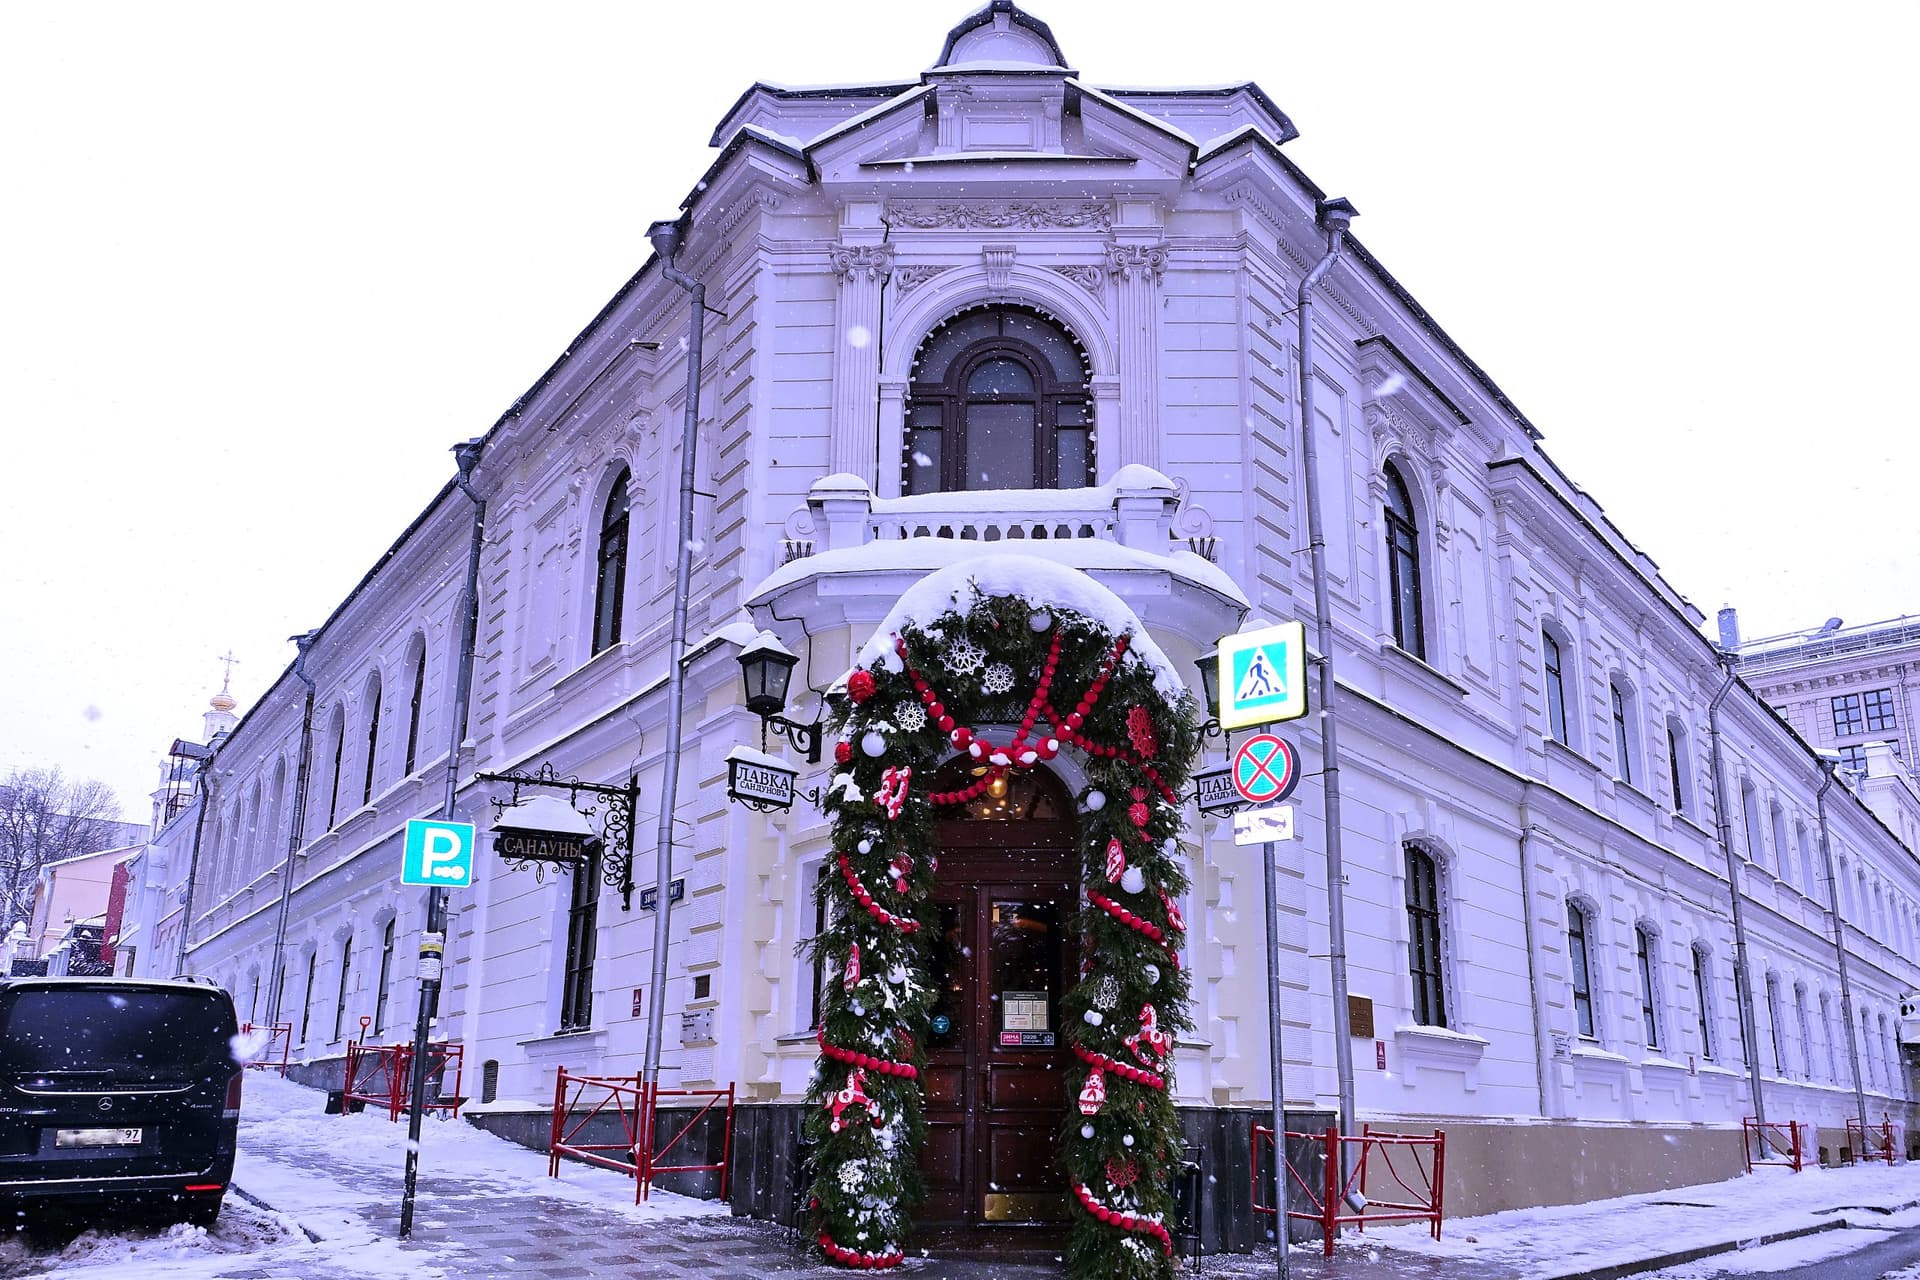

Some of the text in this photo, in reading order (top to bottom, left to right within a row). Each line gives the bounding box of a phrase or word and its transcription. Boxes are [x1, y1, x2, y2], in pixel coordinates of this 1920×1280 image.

[737, 767, 790, 790] ЛАВКА
[1199, 777, 1234, 794] ЛАВ
[740, 782, 787, 797] САНДУНОВЪ
[1204, 789, 1240, 802] САНДУН
[503, 836, 582, 858] САНДУНЫ
[125, 1129, 139, 1139] 97
